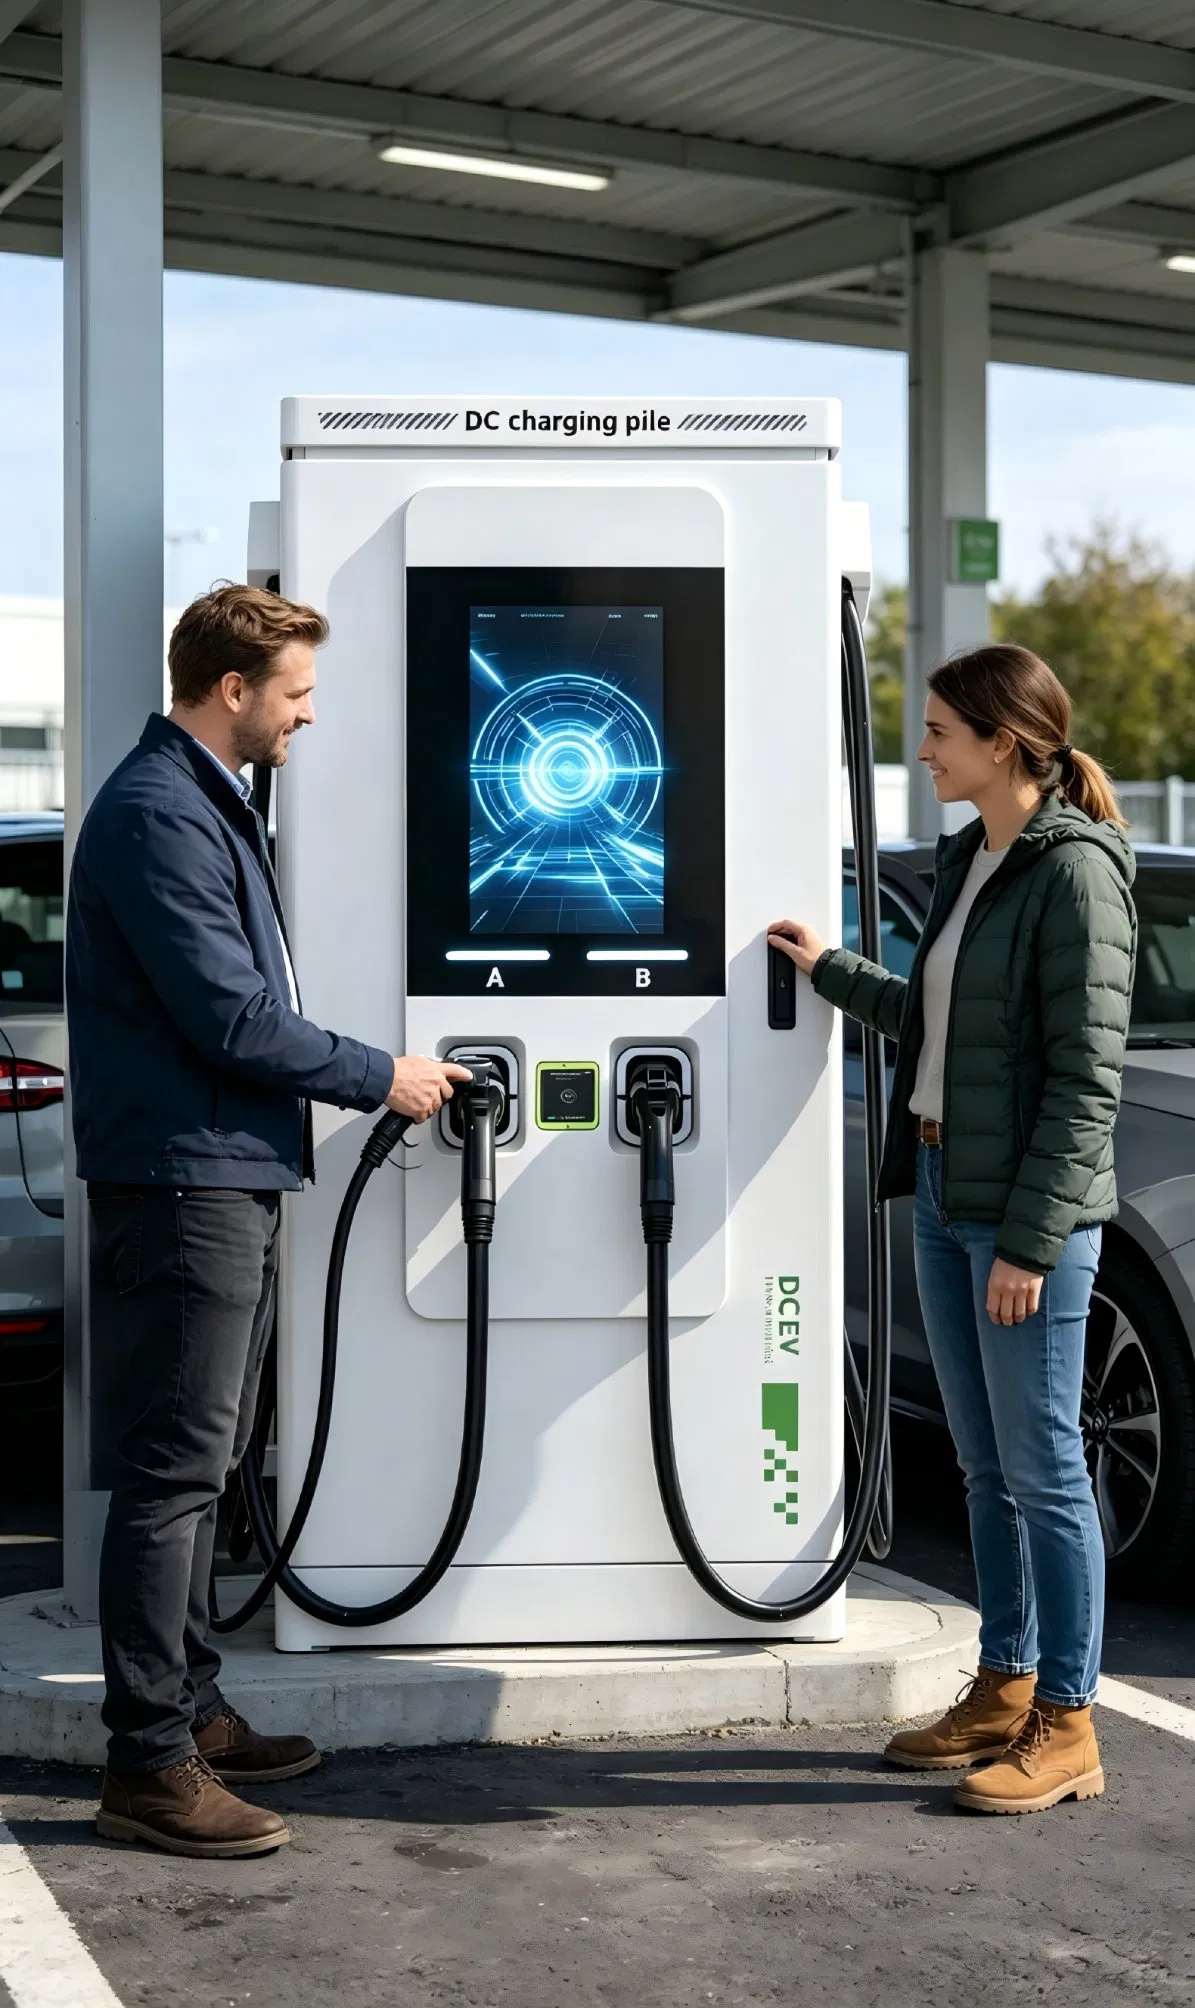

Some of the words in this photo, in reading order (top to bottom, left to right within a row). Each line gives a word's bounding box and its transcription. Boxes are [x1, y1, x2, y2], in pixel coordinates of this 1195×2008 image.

[465, 410, 500, 432] DC
[508, 409, 618, 437] charging
[626, 409, 671, 437] pile
[485, 966, 505, 988] A
[635, 967, 651, 988] B
[778, 1276, 801, 1356] DCEV
